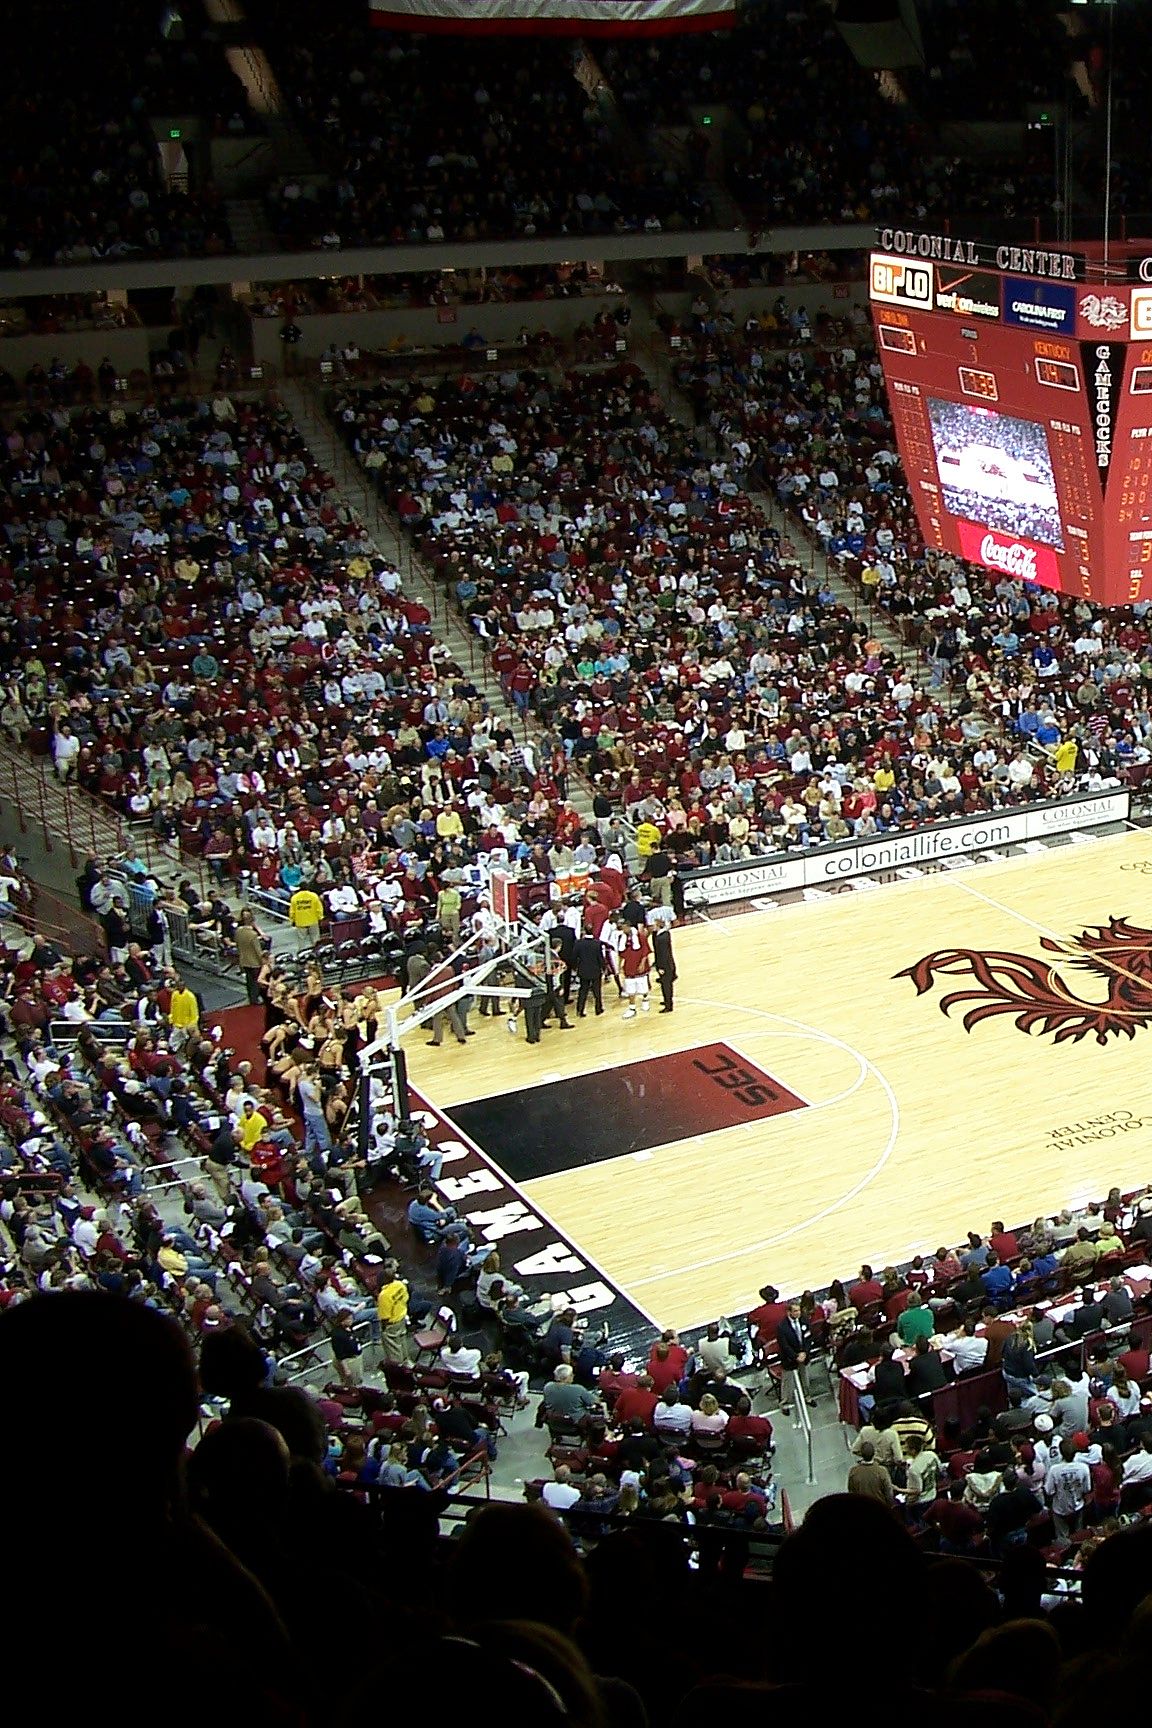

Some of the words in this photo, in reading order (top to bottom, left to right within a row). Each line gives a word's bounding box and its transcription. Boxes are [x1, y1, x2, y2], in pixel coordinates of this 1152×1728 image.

[881, 229, 979, 265] COLONIAL
[996, 246, 1077, 280] CENTER
[1094, 345, 1112, 467] GAMECOCKS
[1141, 542, 1152, 562] 3
[1129, 580, 1140, 598] 3
[825, 825, 1010, 875] coloniallife.com
[701, 865, 787, 891] COLONIAL
[693, 1053, 779, 1107] SEC
[1045, 1110, 1133, 1139] CENTER
